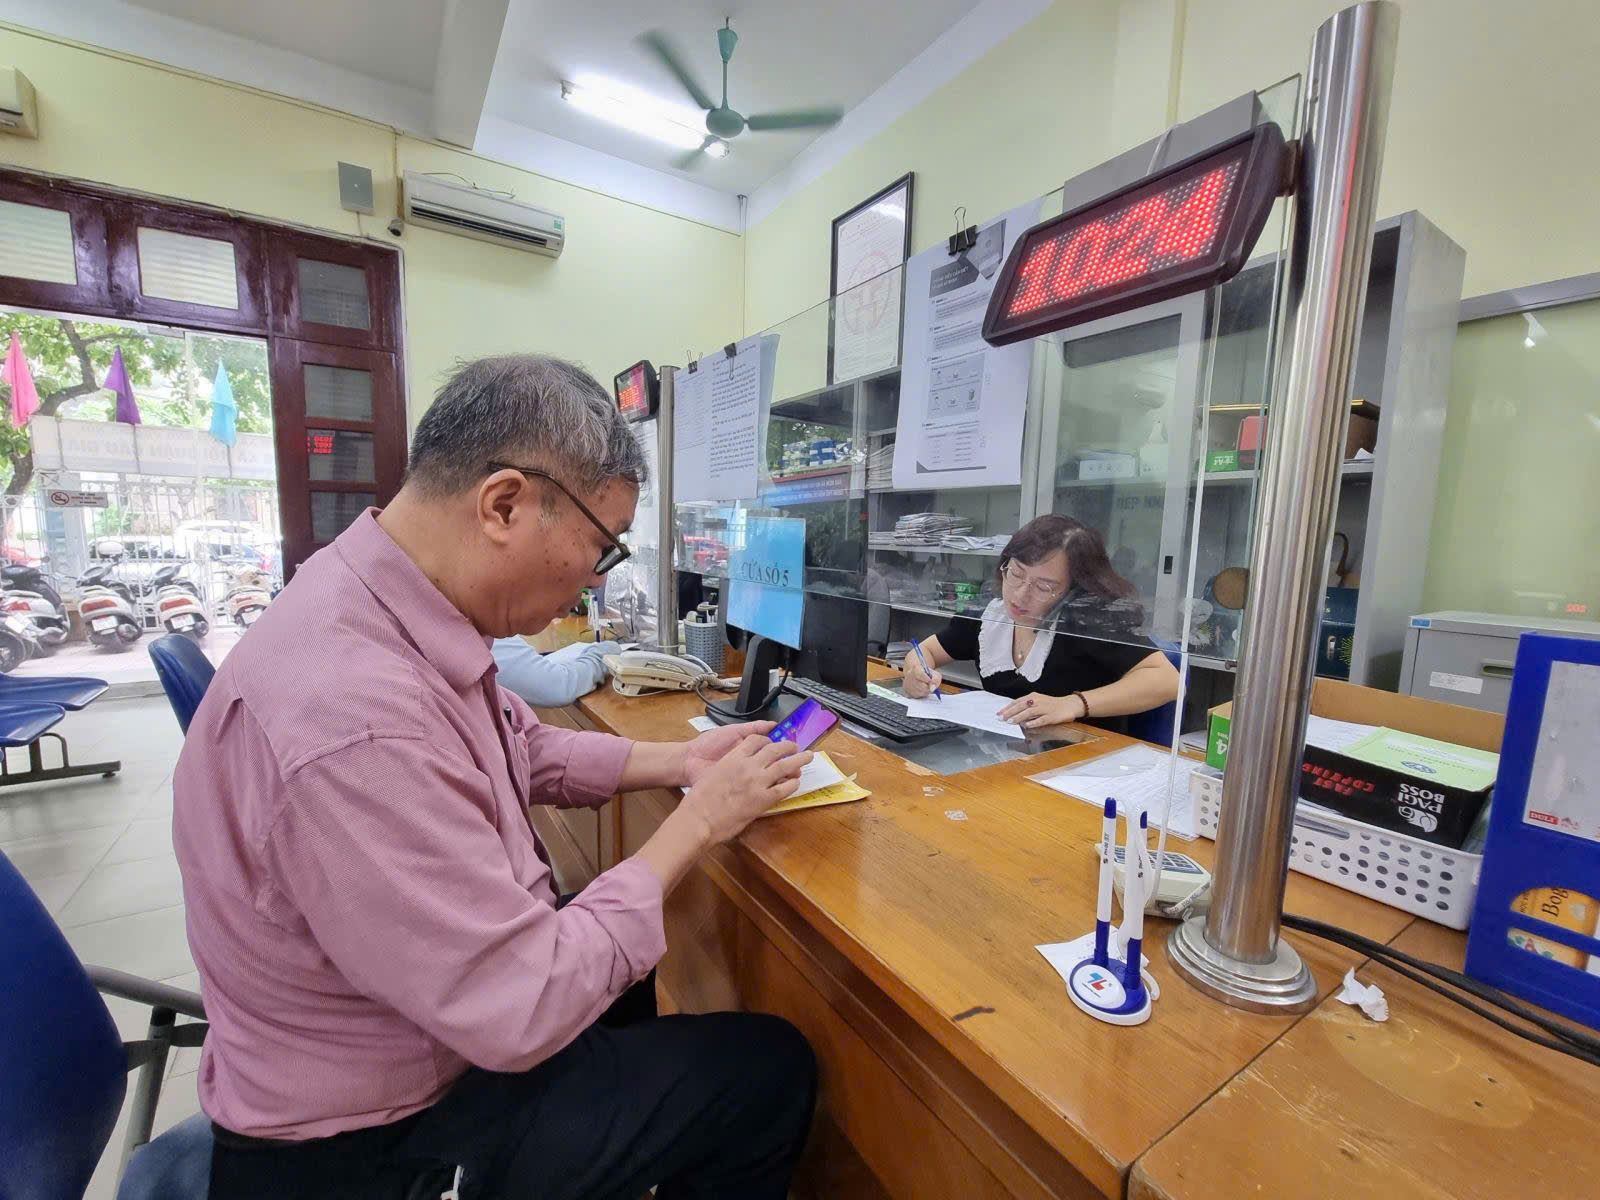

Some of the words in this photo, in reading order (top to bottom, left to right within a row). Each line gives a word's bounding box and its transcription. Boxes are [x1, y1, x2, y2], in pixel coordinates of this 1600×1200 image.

[1008, 168, 1225, 316] 1024
[782, 569, 790, 587] 5
[1313, 777, 1354, 796] FAST
[1400, 783, 1445, 804] BOSS
